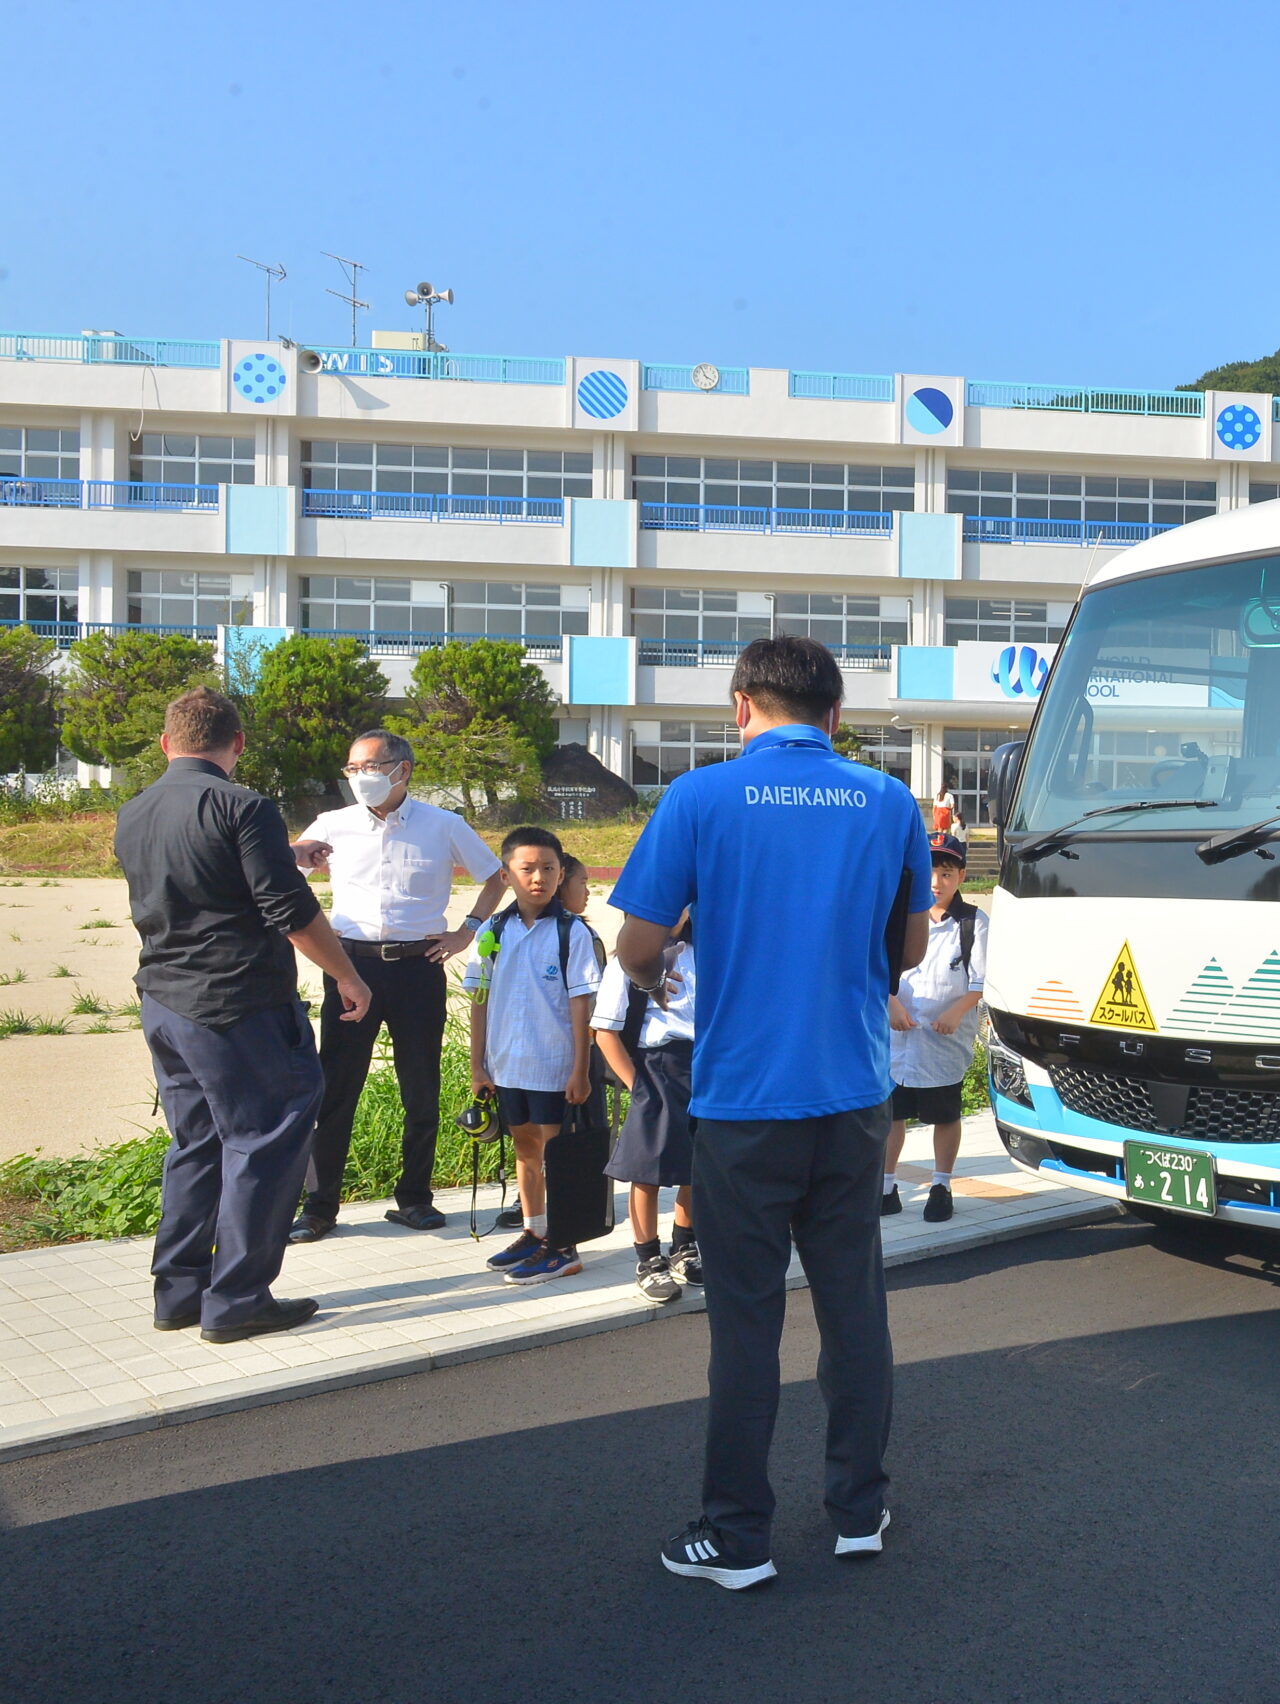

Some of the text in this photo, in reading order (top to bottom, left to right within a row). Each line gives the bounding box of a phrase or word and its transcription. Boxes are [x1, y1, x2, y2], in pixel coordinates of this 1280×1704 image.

[745, 785, 867, 808] DAIEIKANKO
[1099, 1006, 1147, 1025] スクールバス
